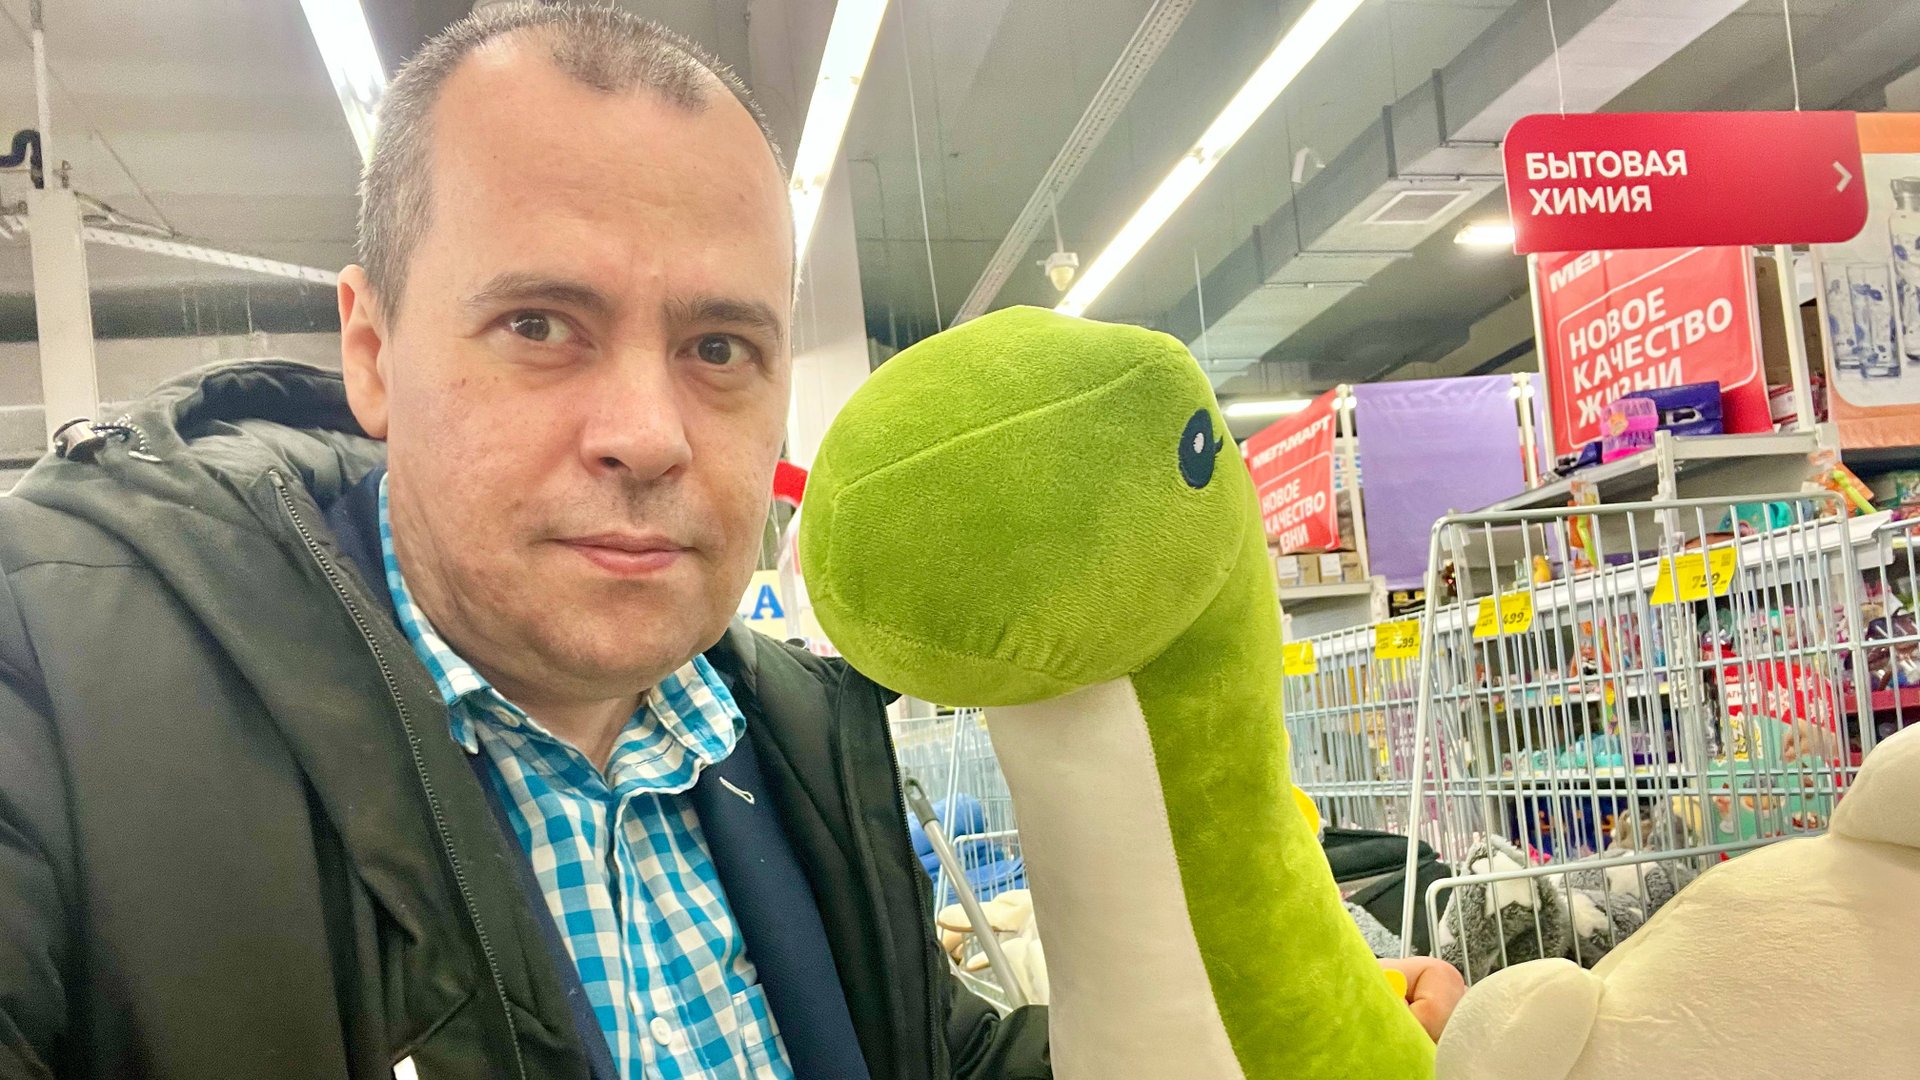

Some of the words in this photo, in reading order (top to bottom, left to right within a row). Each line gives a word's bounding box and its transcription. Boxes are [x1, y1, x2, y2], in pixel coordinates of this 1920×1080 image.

[1525, 149, 1688, 180] БЫТОВАЯ
[1528, 185, 1653, 216] ХИМИЯ
[1569, 286, 1666, 360] НОВОЕ
[1572, 297, 1733, 394] КАЧЕСТВО
[1261, 478, 1301, 516] НОВОЕ
[1265, 490, 1326, 536] КАЧЕСТВО
[743, 583, 785, 620] А
[1502, 611, 1525, 625] 499
